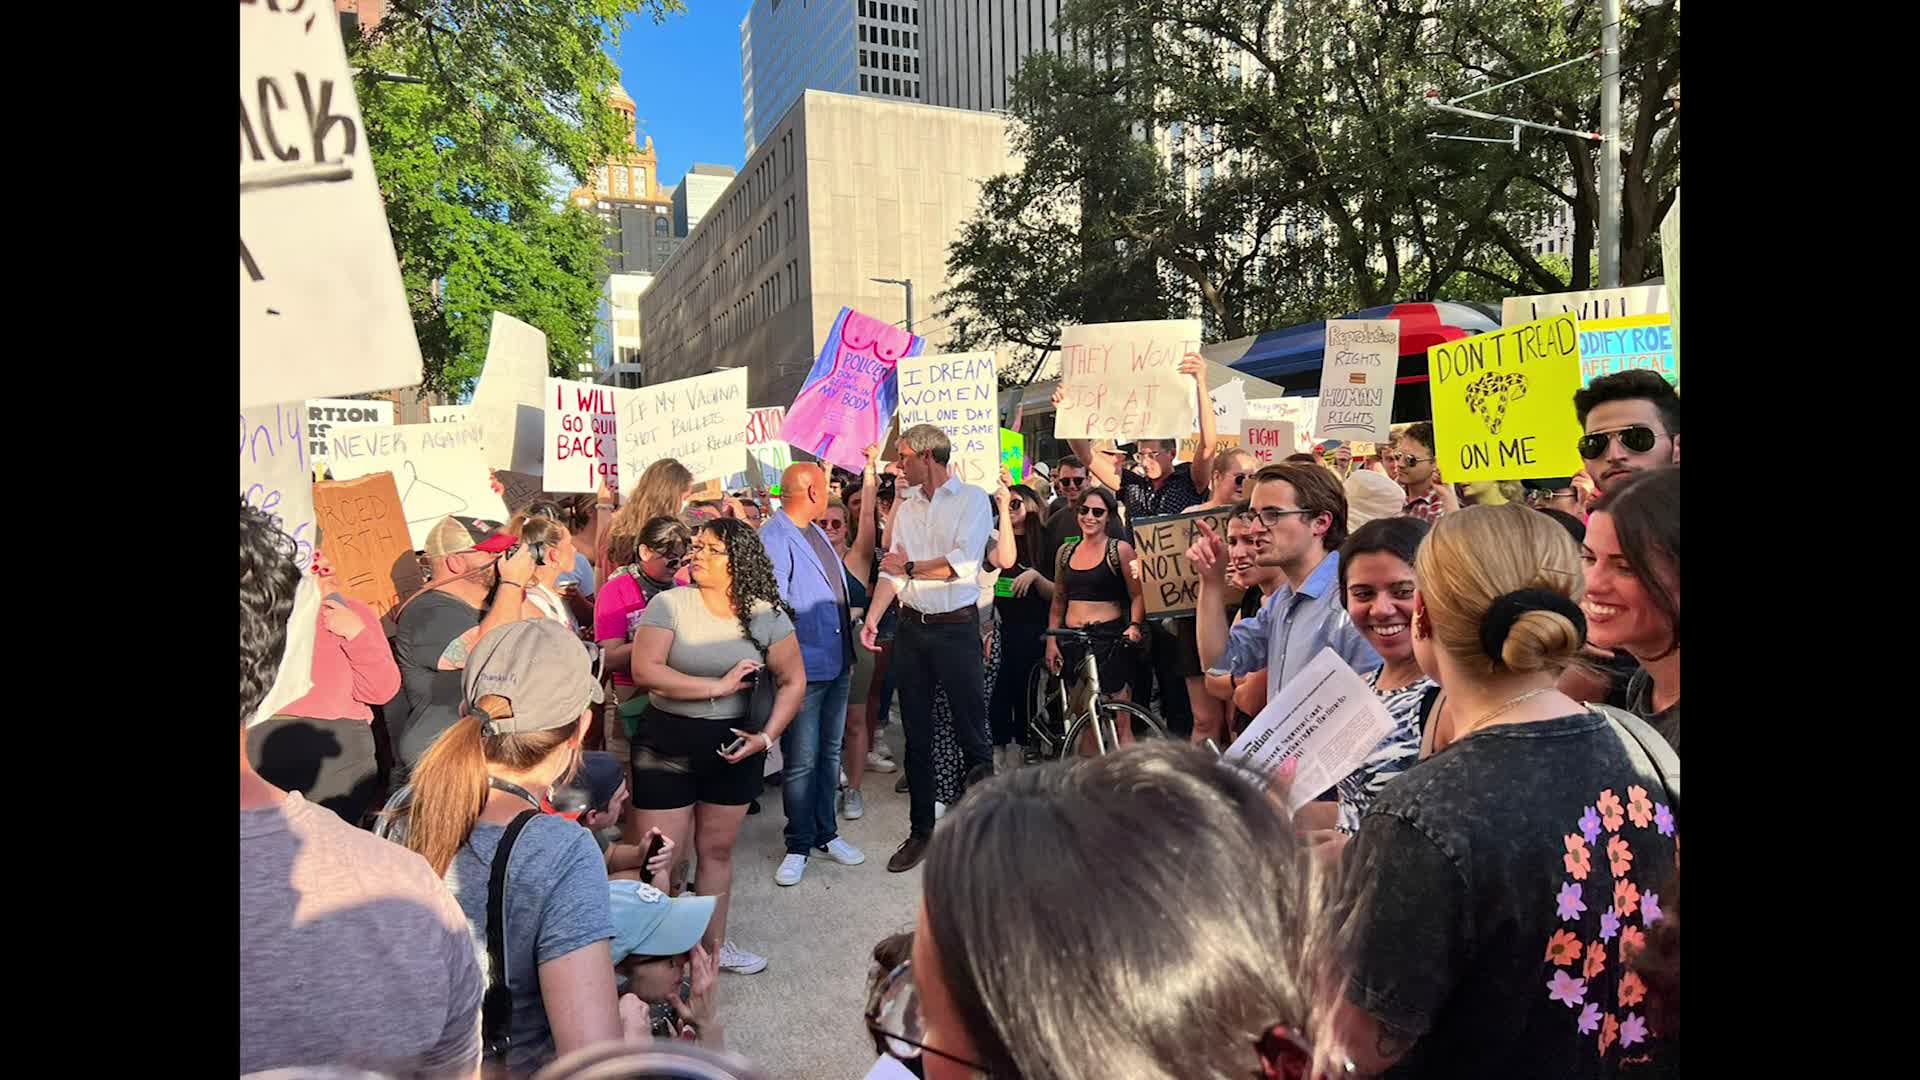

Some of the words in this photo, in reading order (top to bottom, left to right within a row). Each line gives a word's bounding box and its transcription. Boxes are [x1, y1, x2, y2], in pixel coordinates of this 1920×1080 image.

[1436, 333, 1506, 384] DON'T
[1512, 317, 1577, 364] TREAD
[1633, 325, 1672, 354] ROE
[842, 351, 888, 384] POLICIES
[903, 369, 921, 387] I
[929, 358, 994, 384] DREAM
[1063, 344, 1112, 377] THEY
[1335, 351, 1381, 367] RIGHTS
[557, 384, 562, 410] I
[577, 388, 616, 415] WILL
[625, 396, 648, 426] IF
[655, 390, 676, 414] MY
[818, 384, 838, 398] MY
[841, 392, 870, 411] BODY
[901, 384, 990, 406] WOMEN
[1063, 384, 1107, 412] STOP
[1124, 383, 1160, 411] AT
[1321, 388, 1383, 407] HUMAN
[308, 407, 378, 422] RTION
[562, 414, 583, 433] GO
[901, 409, 934, 423] WILL
[936, 409, 958, 421] ONE
[966, 408, 992, 421] DAY
[1328, 411, 1375, 424] RIGHTS
[625, 427, 661, 448] SHOT
[671, 412, 724, 437] BULLETS
[962, 424, 993, 436] SAME
[1248, 427, 1280, 447] FIGHT
[333, 431, 408, 461] NEVER
[557, 434, 604, 460] BACK
[966, 440, 984, 452] AS
[1255, 449, 1272, 462] ME
[1460, 441, 1489, 470] ON
[1499, 436, 1537, 467] ME
[1134, 524, 1175, 554] WE
[1141, 552, 1181, 583] NOT
